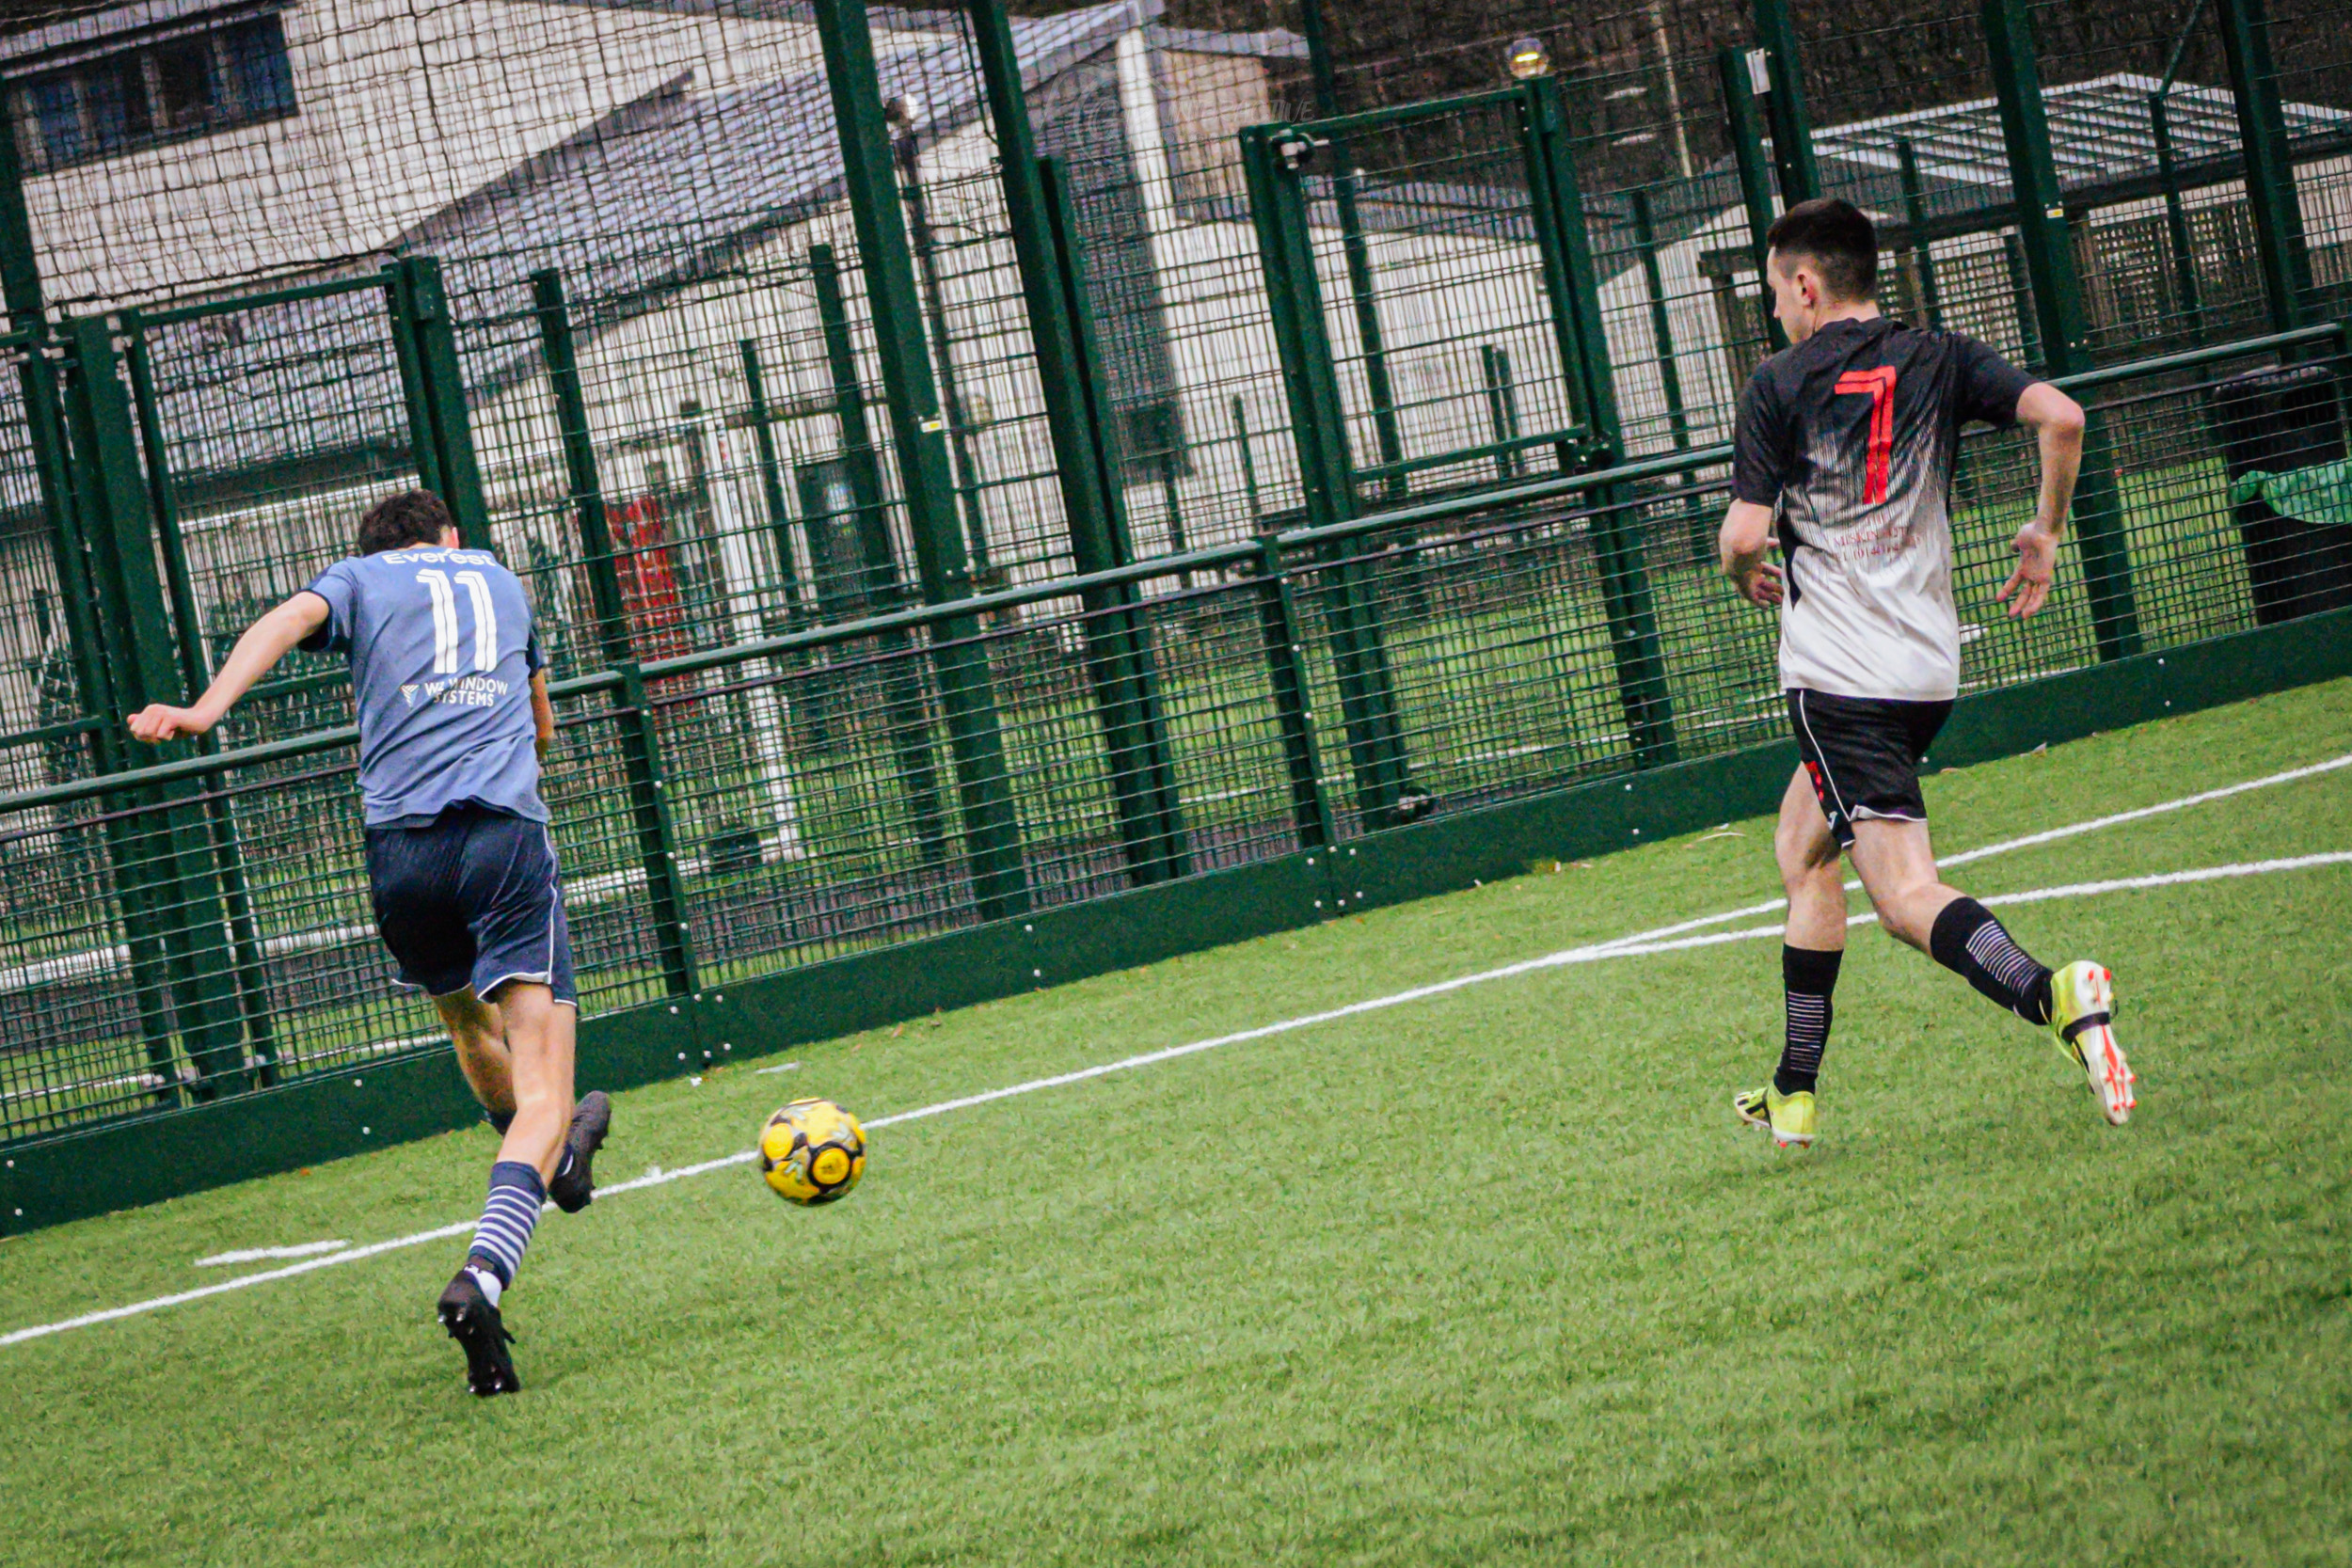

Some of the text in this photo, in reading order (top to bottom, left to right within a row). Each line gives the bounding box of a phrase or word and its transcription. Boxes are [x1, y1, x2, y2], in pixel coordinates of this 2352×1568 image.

[1834, 365, 1897, 505] 7
[381, 548, 496, 566] Everest
[415, 568, 497, 673] 11
[448, 676, 509, 696] WINDOW
[433, 689, 495, 707] SYSTEMS
